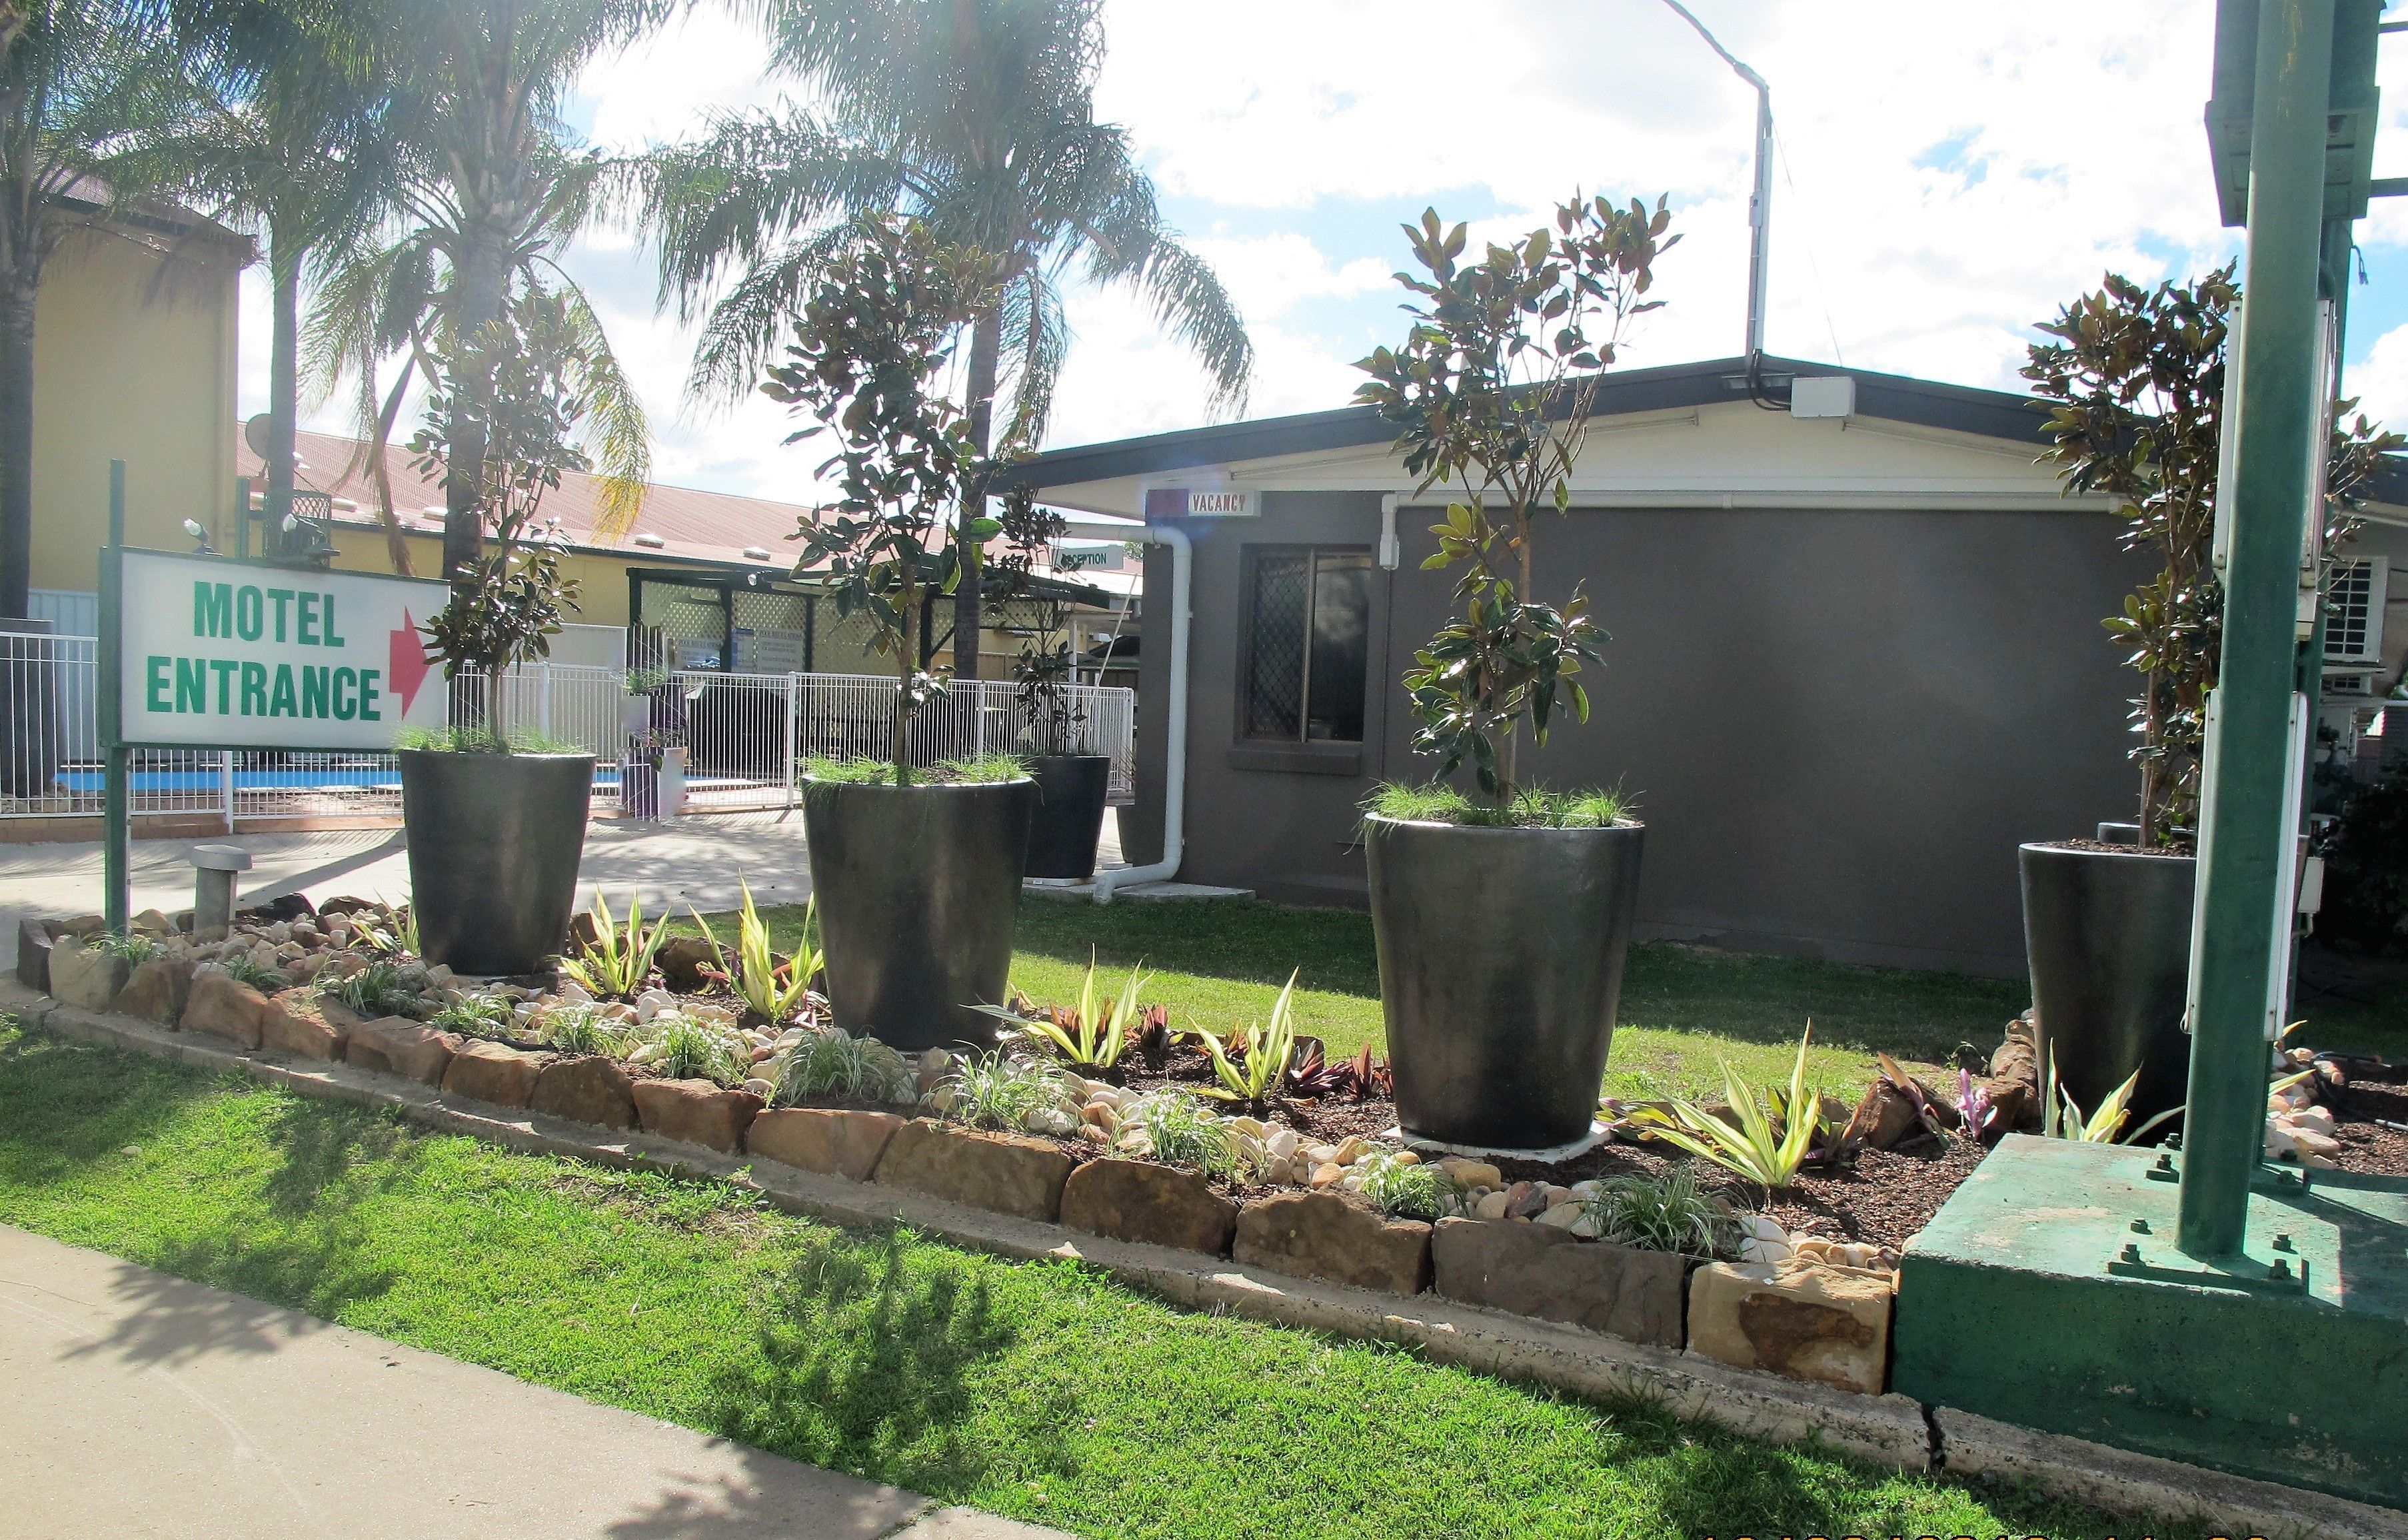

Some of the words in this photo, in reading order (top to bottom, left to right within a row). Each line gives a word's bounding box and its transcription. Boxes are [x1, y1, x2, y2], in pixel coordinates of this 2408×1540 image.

[1192, 494, 1246, 512] VACANCY
[1061, 553, 1106, 565] CEPTION
[194, 580, 345, 647] MOTEL
[147, 656, 381, 722] ENTRANCE
